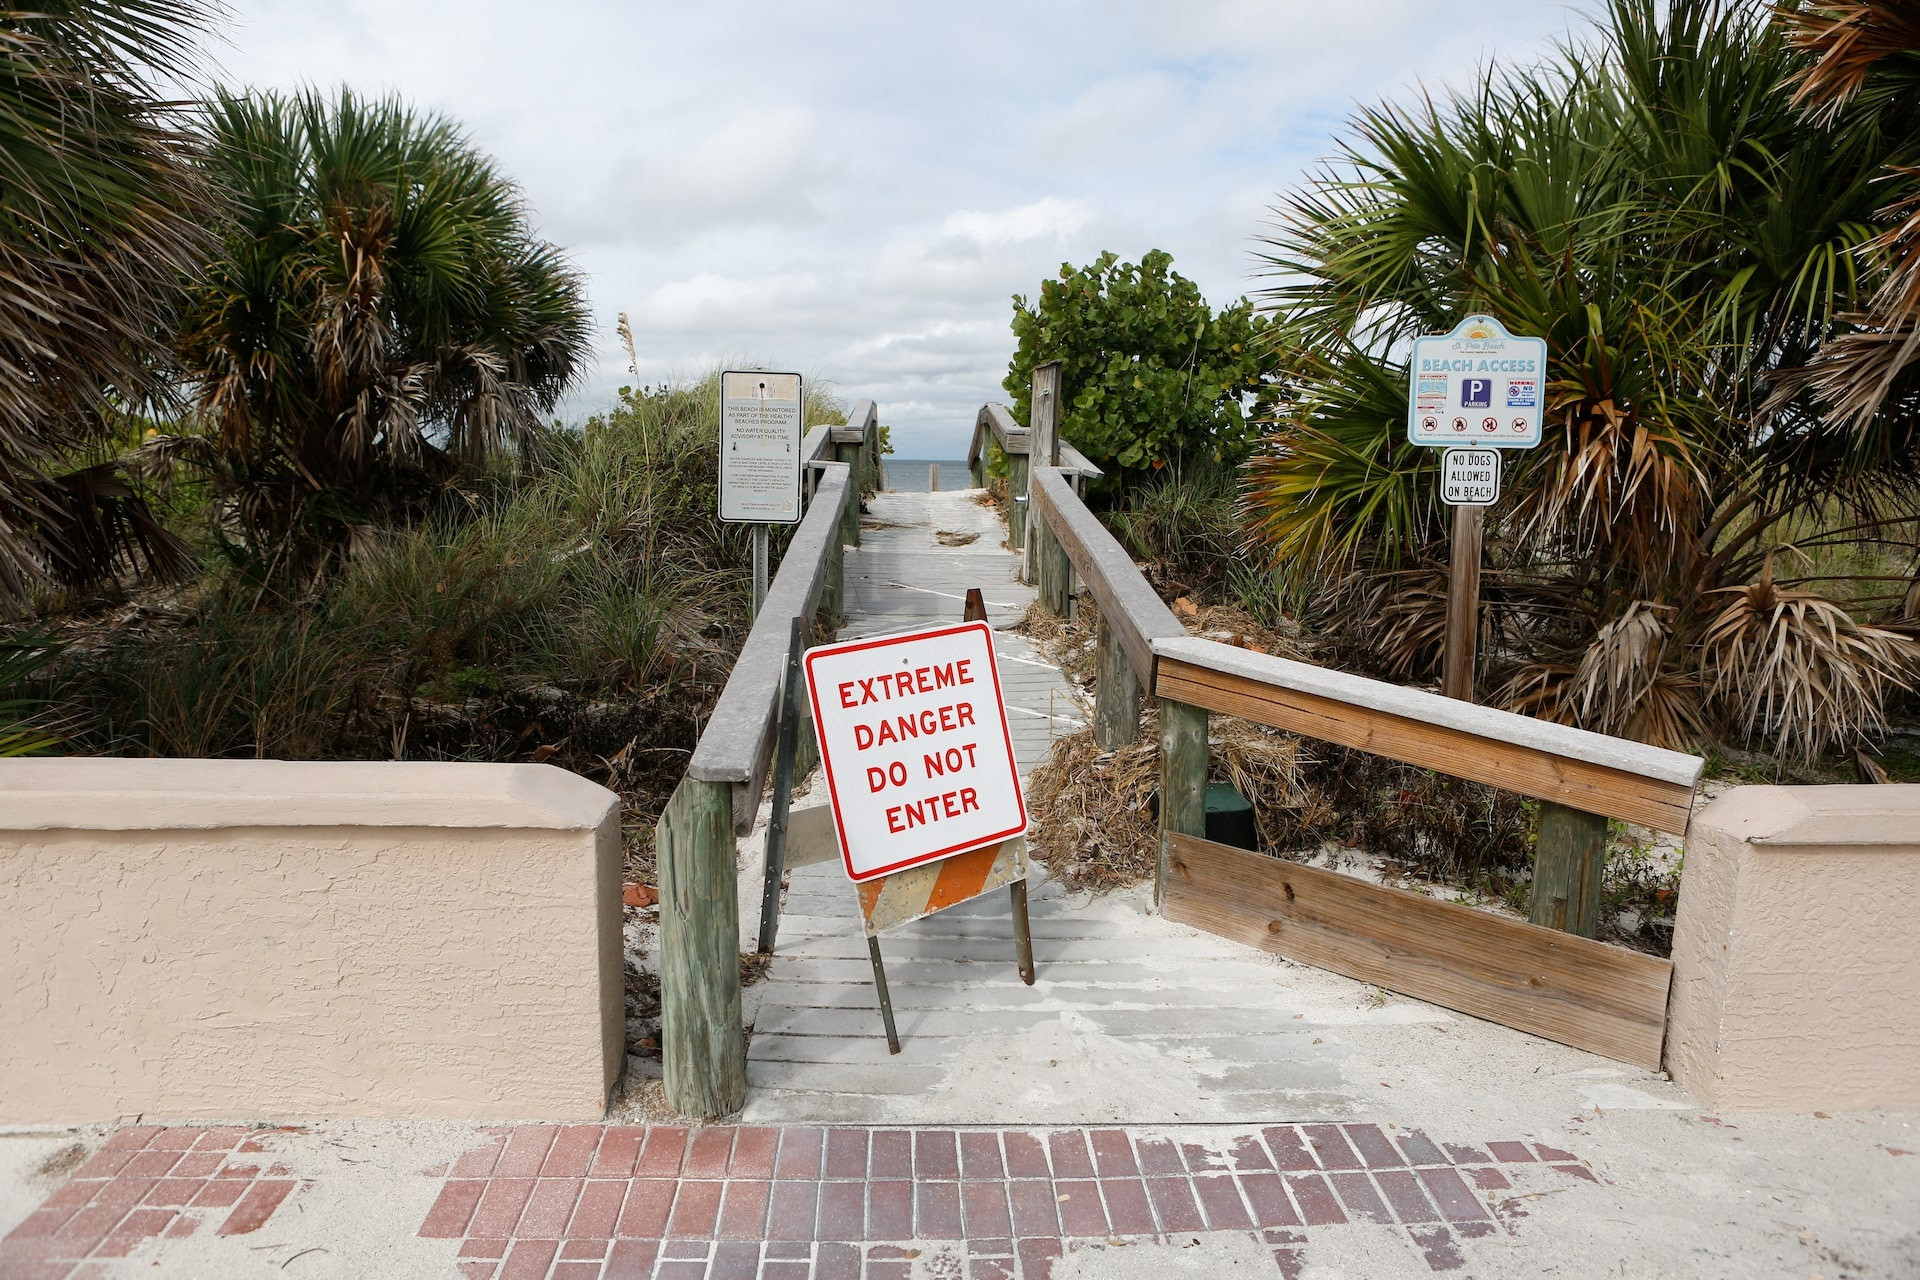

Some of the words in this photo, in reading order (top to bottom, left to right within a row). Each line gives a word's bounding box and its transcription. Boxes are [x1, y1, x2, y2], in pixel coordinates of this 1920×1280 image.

[1482, 342, 1505, 350] Beach
[1422, 359, 1473, 372] BEACH
[1476, 360, 1536, 372] ACCESS
[1470, 380, 1483, 400] P
[1453, 455, 1464, 465] NO
[1468, 456, 1491, 466] DOGS
[1451, 471, 1490, 481] ALLOWED
[1448, 486, 1459, 496] ON
[1464, 487, 1491, 497] BEACH
[838, 659, 974, 709] EXTREME
[854, 702, 976, 750] DANGER
[866, 761, 908, 793] DO
[924, 743, 977, 779] NOT
[886, 787, 980, 834] ENTER
